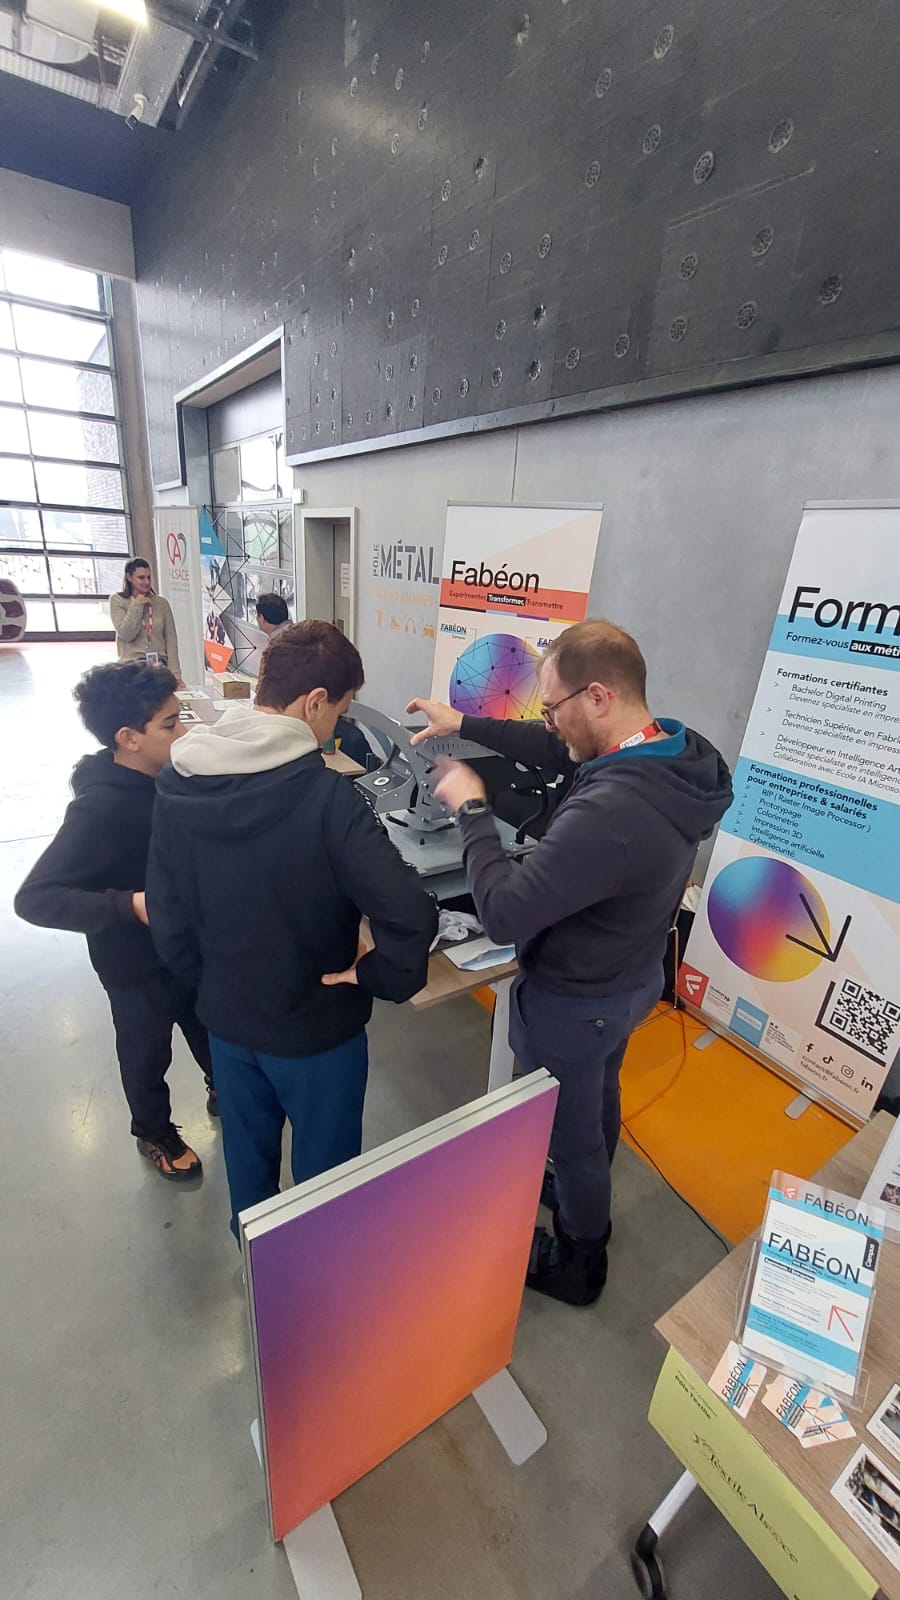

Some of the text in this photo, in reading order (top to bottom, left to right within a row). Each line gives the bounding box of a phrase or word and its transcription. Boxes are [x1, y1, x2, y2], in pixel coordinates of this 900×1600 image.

[381, 539, 440, 584] MÉTAL
[450, 560, 540, 593] Fabéon
[788, 586, 900, 636] Form
[440, 623, 467, 634] FABÉON
[786, 632, 849, 648] Formez-vous
[851, 642, 872, 653] aux
[777, 668, 889, 697] Formations certifiantes
[789, 694, 821, 705] Devenez
[821, 700, 861, 714] spécialiste
[792, 684, 887, 712] Bachelor Digital Printing
[782, 719, 813, 732] Devenez
[814, 727, 854, 742] spécialiste
[855, 738, 867, 746] en
[785, 710, 822, 725] Technicien
[823, 719, 862, 734] Supérieur
[864, 730, 875, 738] en
[773, 751, 817, 769] Collaboration
[775, 742, 806, 756] Devenez
[806, 752, 846, 768] spécialiste
[847, 764, 858, 772] en
[777, 734, 825, 753] Développeur
[838, 750, 886, 770] Intelligence
[747, 775, 867, 820] pour entreprises & salariés
[750, 764, 878, 811] Formations professionnelles
[757, 807, 799, 828] Colorimétrie
[759, 798, 802, 819] Prototypage
[762, 789, 774, 797] RIP
[778, 794, 800, 809] Raster
[801, 803, 826, 817] Image
[826, 811, 866, 831] Processor
[751, 825, 825, 859] Intelligence artificielle
[753, 816, 803, 840] Impression 3D
[748, 833, 795, 858] Cybersécurité
[804, 1192, 869, 1227] FABÉON
[768, 1232, 860, 1285] FABÉON
[721, 1358, 747, 1399] FABÉON
[776, 1381, 804, 1418] FABÉON
